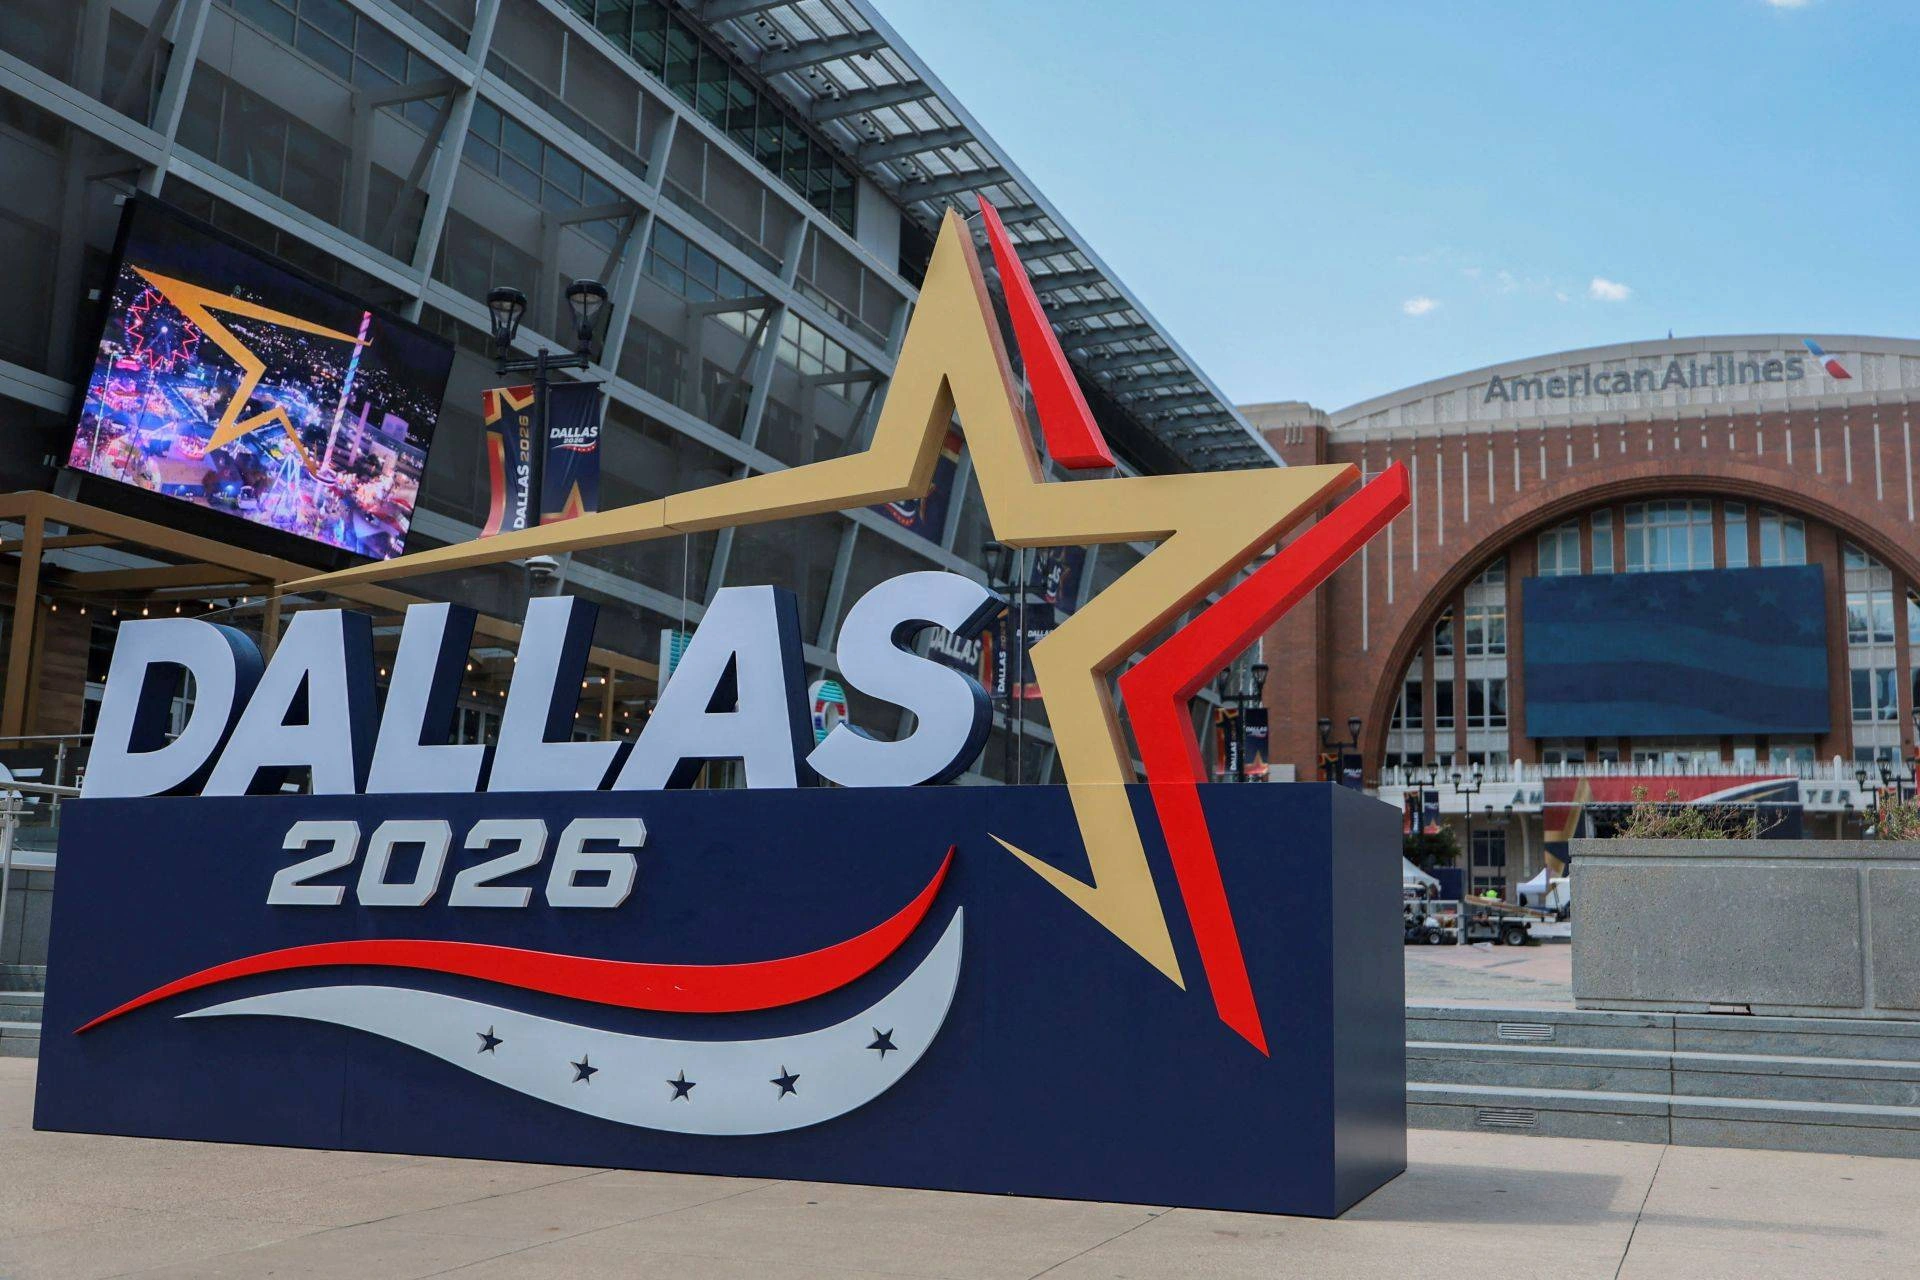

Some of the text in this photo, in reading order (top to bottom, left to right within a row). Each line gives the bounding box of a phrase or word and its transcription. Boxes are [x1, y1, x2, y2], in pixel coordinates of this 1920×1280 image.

[1484, 354, 1806, 403] American Airlines
[550, 426, 599, 440] DALLAS
[513, 415, 530, 529] DALLAS 2026
[80, 570, 992, 799] DALLAS
[998, 651, 1007, 693] DALLAS
[1229, 742, 1237, 771] DALLAS
[266, 817, 648, 909] 2026
